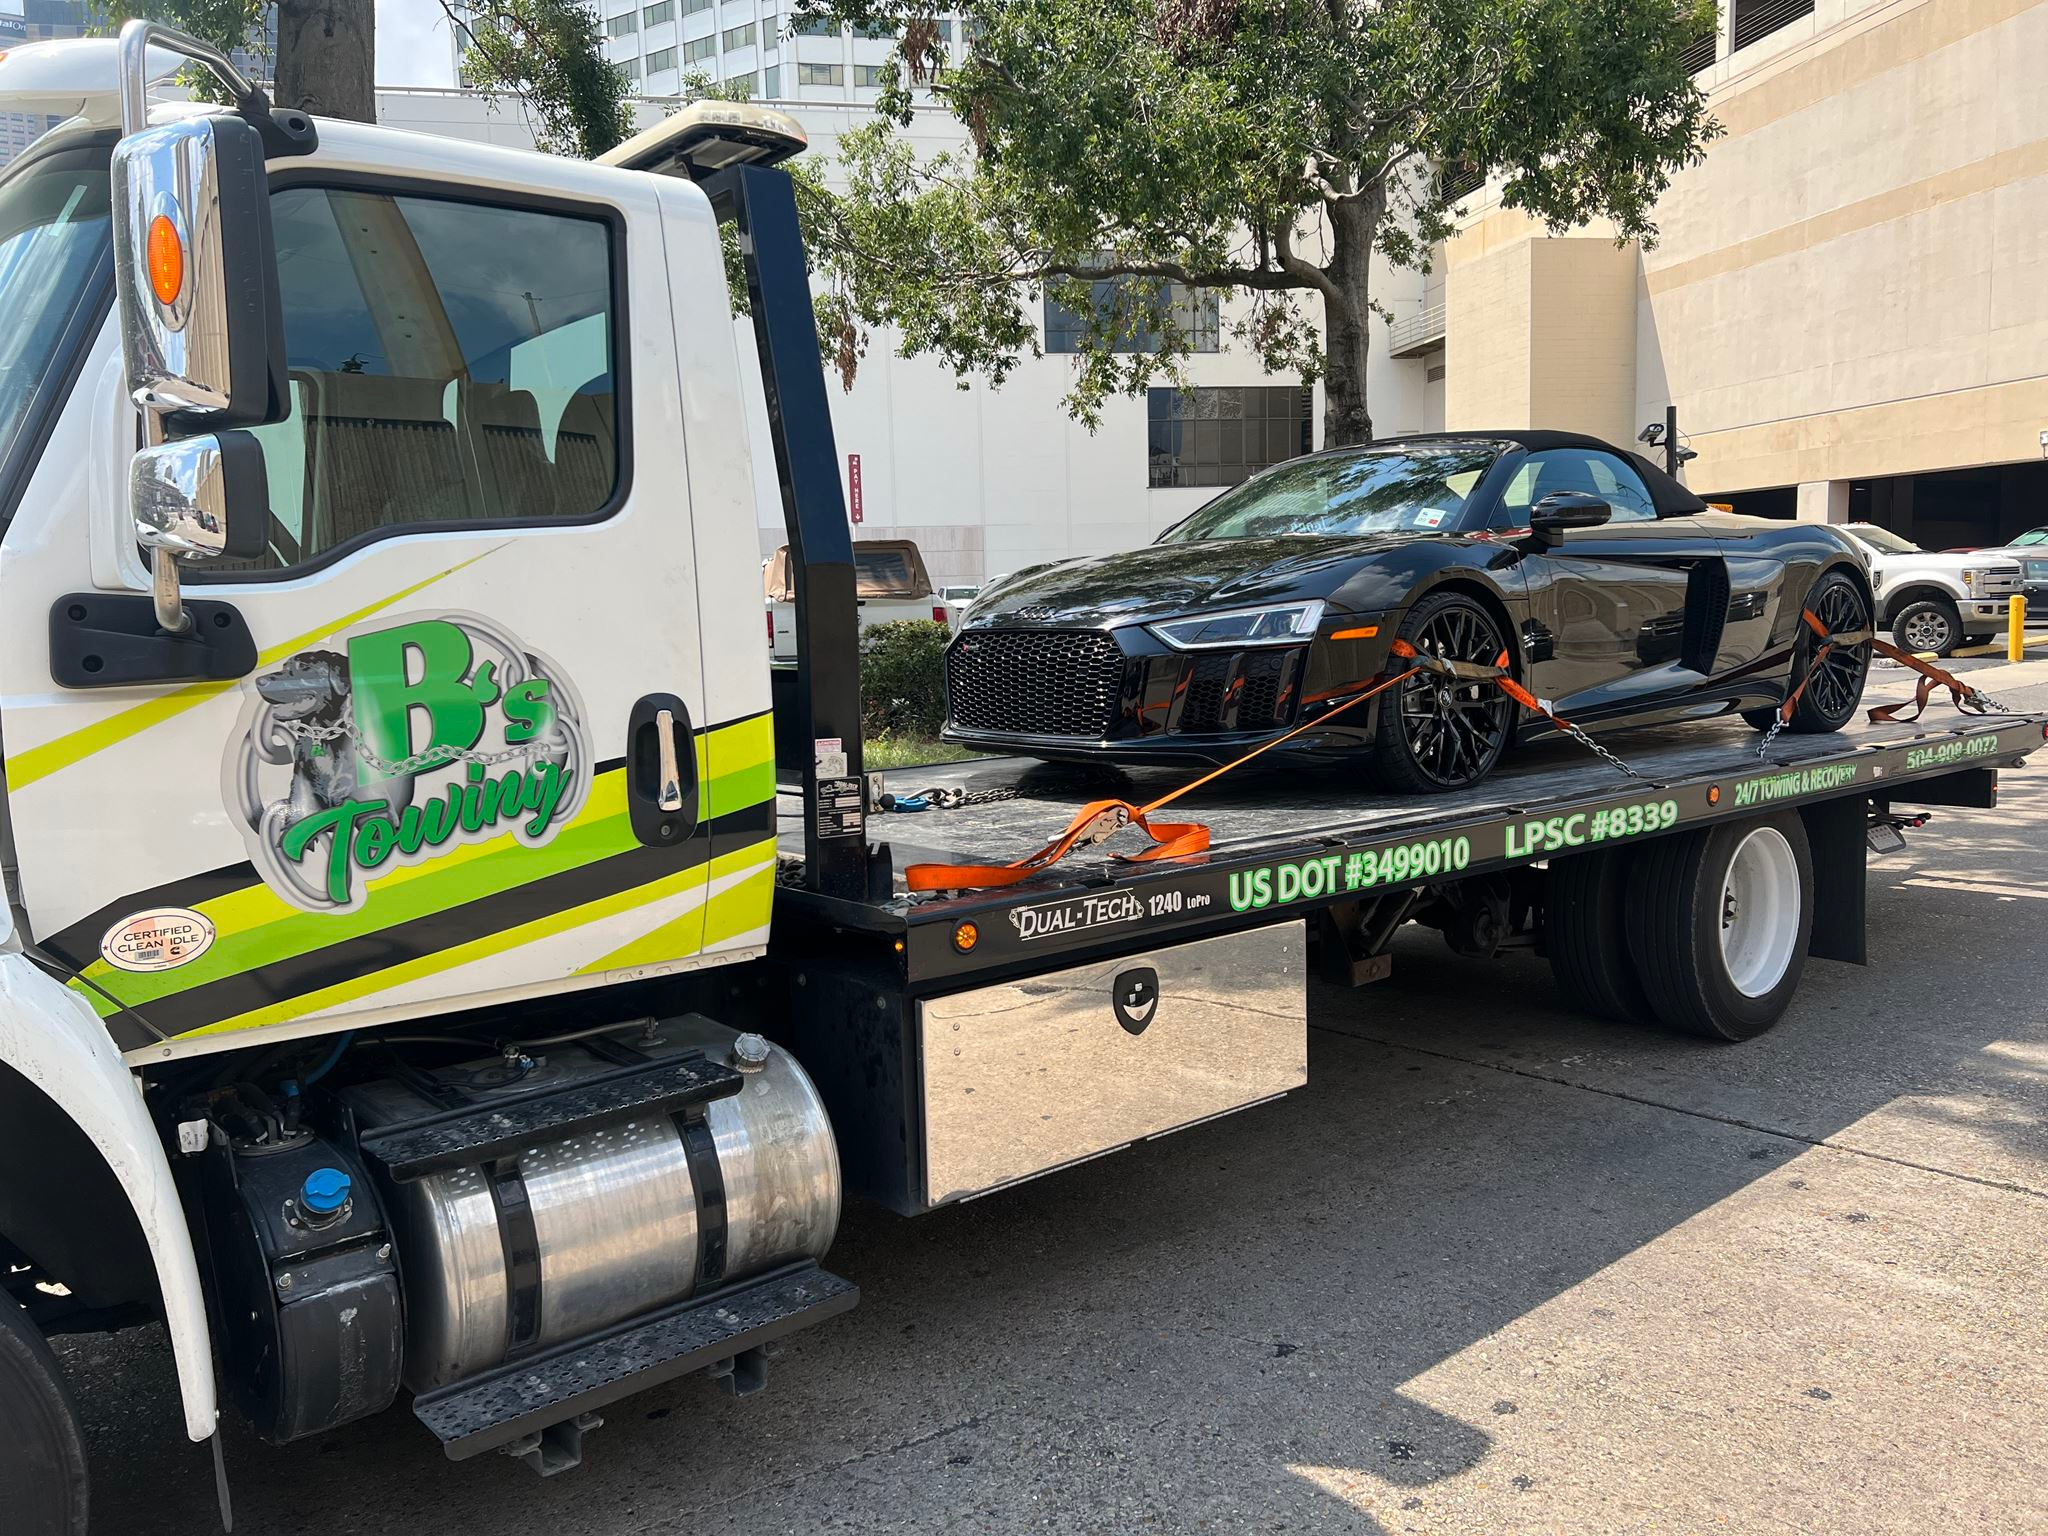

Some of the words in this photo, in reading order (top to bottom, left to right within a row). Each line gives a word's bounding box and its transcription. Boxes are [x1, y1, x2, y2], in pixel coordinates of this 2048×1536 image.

[347, 619, 558, 788] B's
[1734, 779, 1759, 806] 24/7
[1759, 771, 1801, 801] TOWING
[1801, 769, 1810, 793] &
[1810, 763, 1858, 791] RECOVERY
[281, 758, 574, 905] Towing
[1504, 812, 1587, 860] LPSC
[1590, 799, 1679, 842] #8339
[1228, 866, 1272, 912] US
[1277, 855, 1342, 903] DOT
[1344, 836, 1471, 890] #3499010
[1149, 890, 1183, 917] 1240
[1186, 894, 1211, 910] LoPro
[117, 940, 164, 953] CLEAN
[170, 934, 199, 946] IDLE
[123, 925, 193, 942] CERTIFIED
